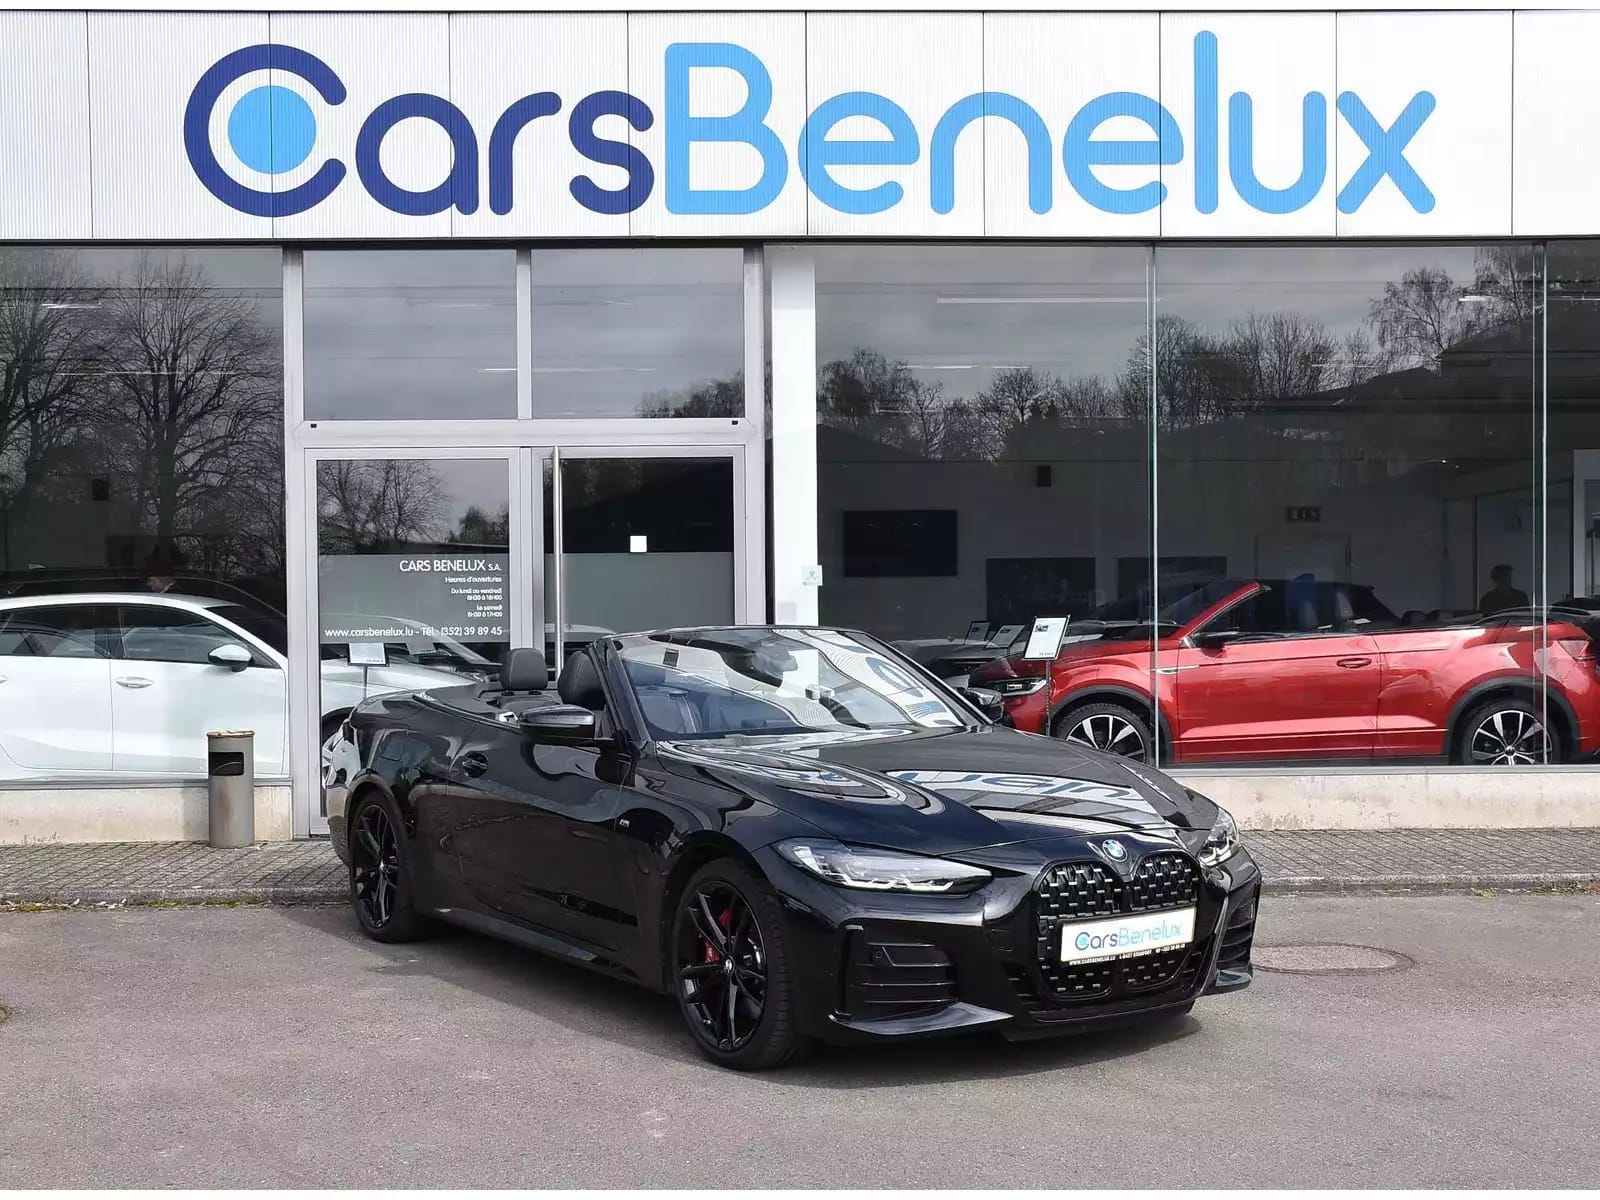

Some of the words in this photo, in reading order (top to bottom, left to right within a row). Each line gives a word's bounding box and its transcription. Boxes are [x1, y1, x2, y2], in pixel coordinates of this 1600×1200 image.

[183, 30, 1437, 217] CarsBenelux
[400, 560, 431, 571] CARS
[433, 560, 486, 571] BENELUX
[325, 627, 413, 637] www.carsbenelux.lu
[441, 626, 462, 636] (352)
[464, 627, 475, 635] 39
[478, 627, 489, 635] 89
[491, 627, 502, 635] 45
[1074, 920, 1183, 950] CarsBenelux
